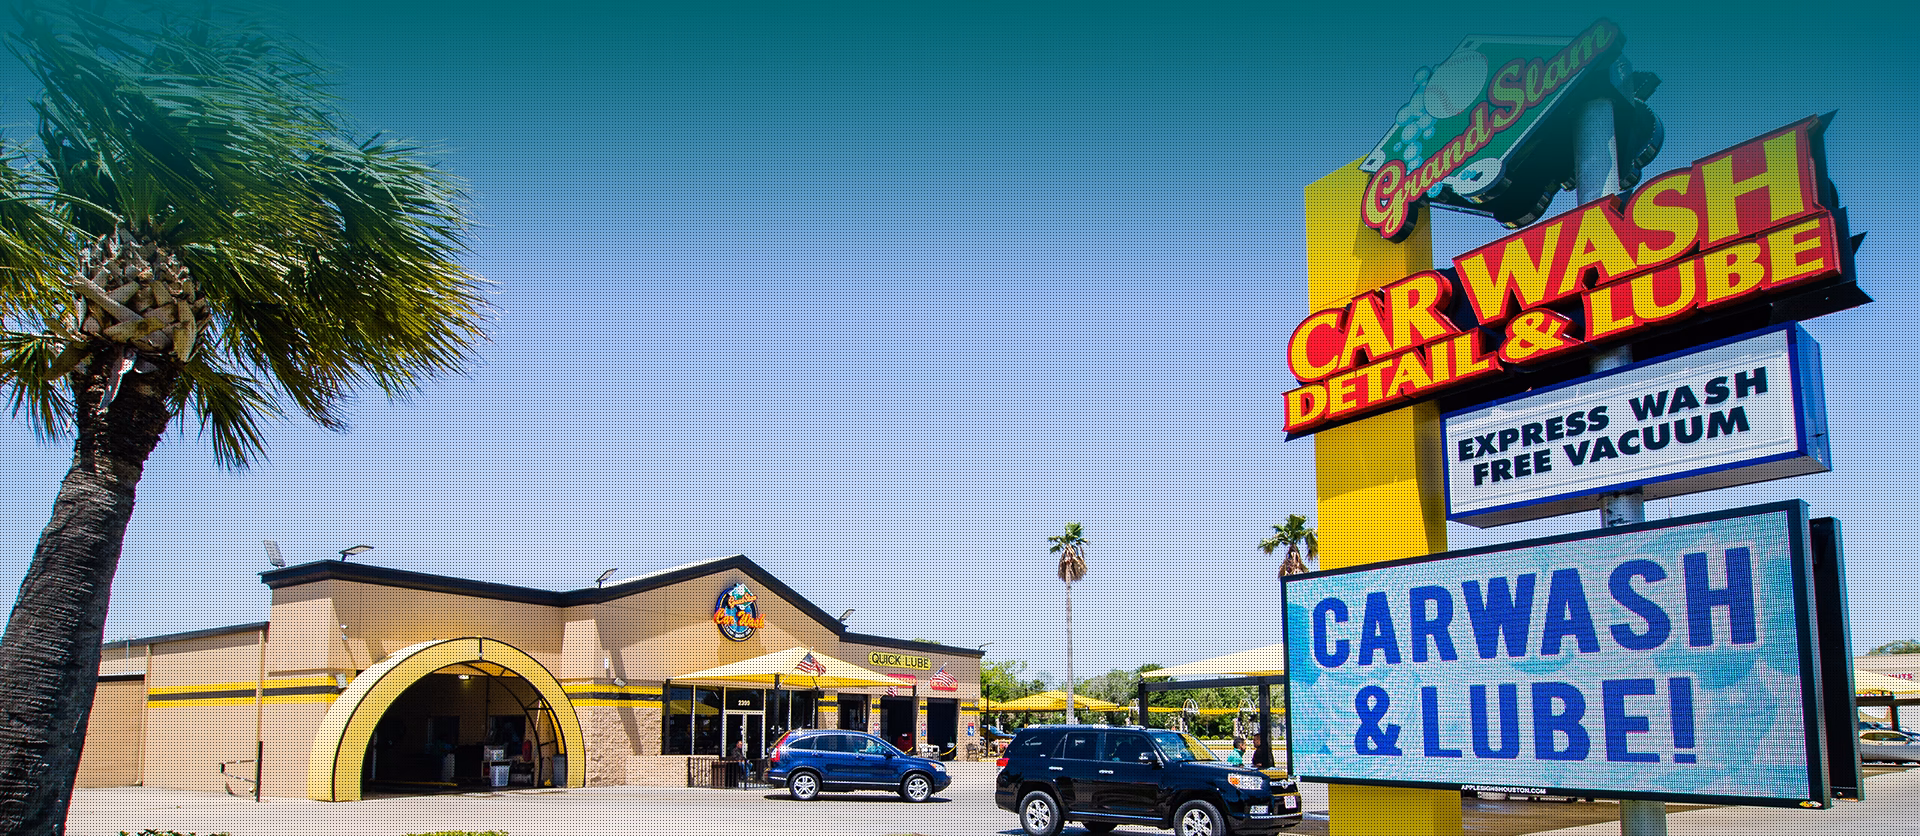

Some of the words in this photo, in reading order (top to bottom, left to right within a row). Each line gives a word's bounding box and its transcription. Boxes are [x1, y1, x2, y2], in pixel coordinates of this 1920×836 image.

[1365, 104, 1492, 235] Grand
[1490, 24, 1613, 129] Slam
[1287, 274, 1456, 382] CAR
[1458, 126, 1808, 323] WASH
[1286, 332, 1492, 430] DETAIL
[1502, 309, 1570, 364] &
[1582, 218, 1826, 343] LUBE
[1458, 405, 1611, 462] EXPRESS
[1628, 366, 1769, 422] WASH
[1473, 448, 1553, 487] FREE
[1563, 406, 1751, 467] VACUUM
[737, 610, 767, 629] Wash
[1311, 546, 1758, 669] CARWASH
[871, 652, 901, 666] QUICK
[905, 656, 929, 669] LUBE
[1353, 685, 1403, 758] &
[1420, 676, 1697, 765] LUBE!
